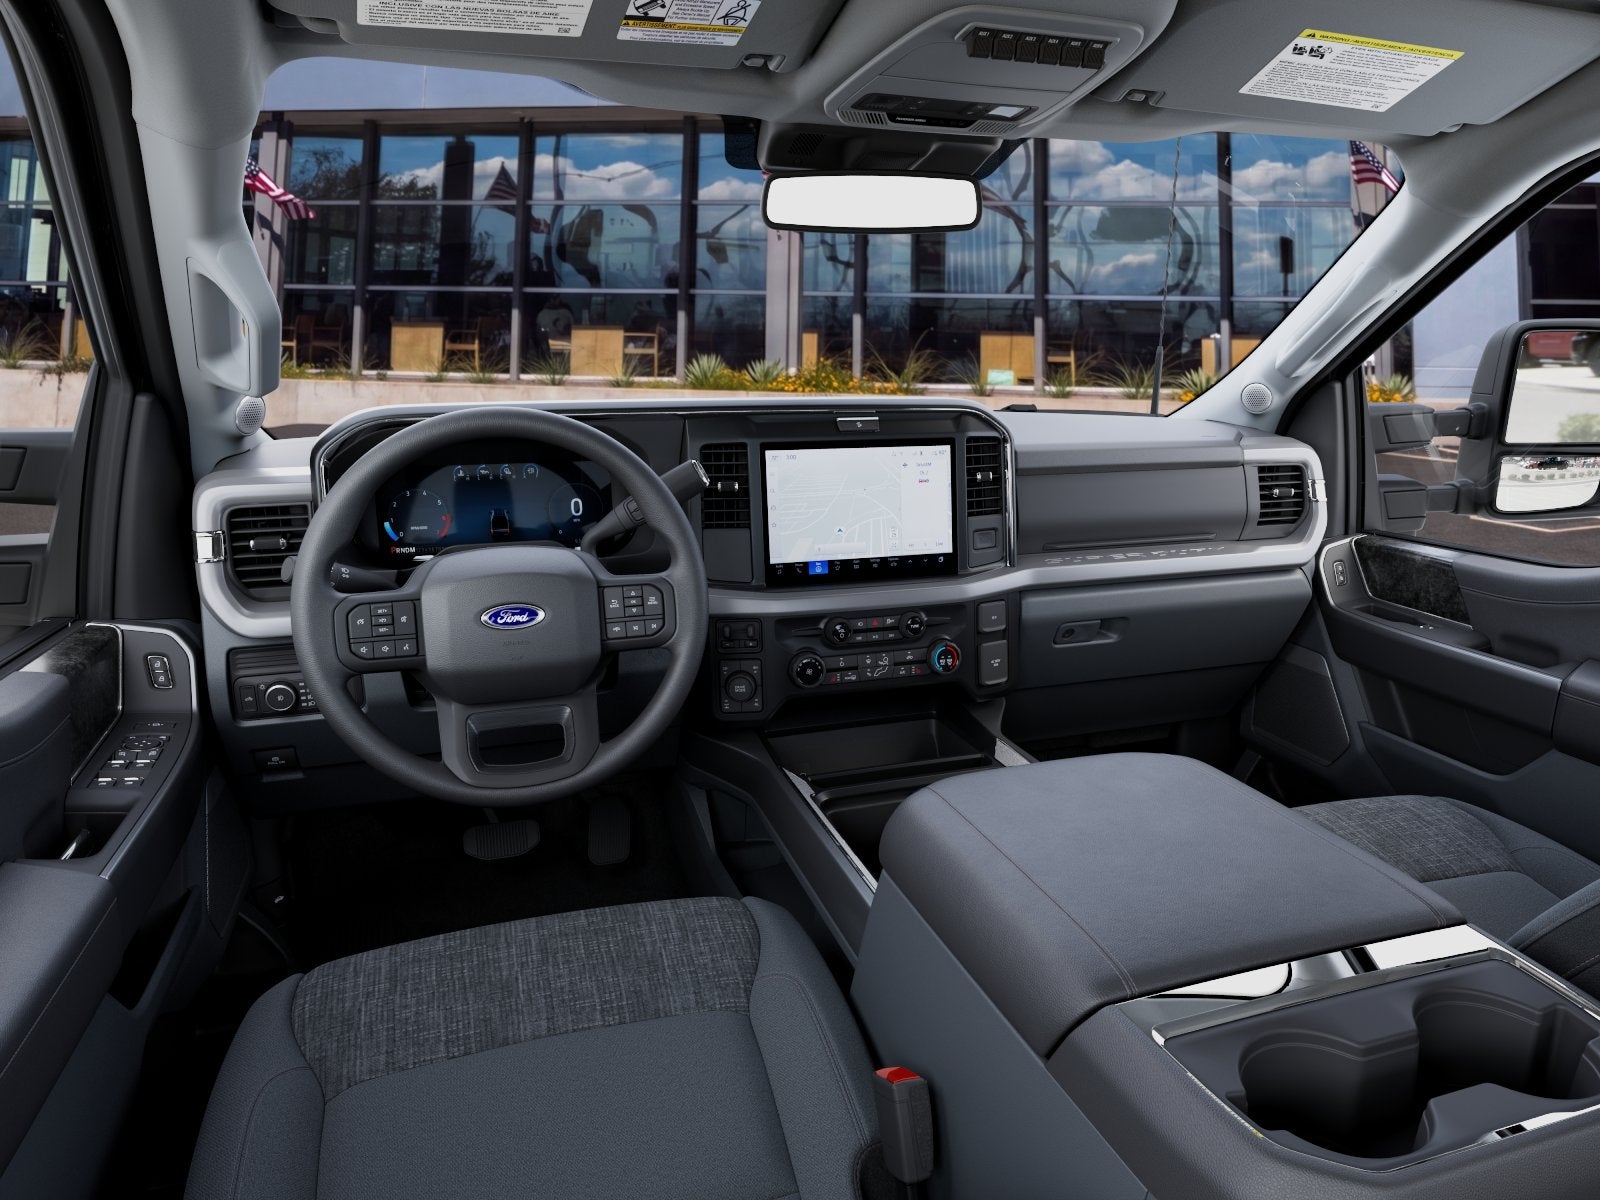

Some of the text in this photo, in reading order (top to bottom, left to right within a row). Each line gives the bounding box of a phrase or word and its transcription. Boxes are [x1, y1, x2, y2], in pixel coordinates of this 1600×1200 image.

[632, 20, 677, 28] AVERTISSEMENT
[570, 497, 583, 516] 0
[497, 610, 529, 624] Ford
